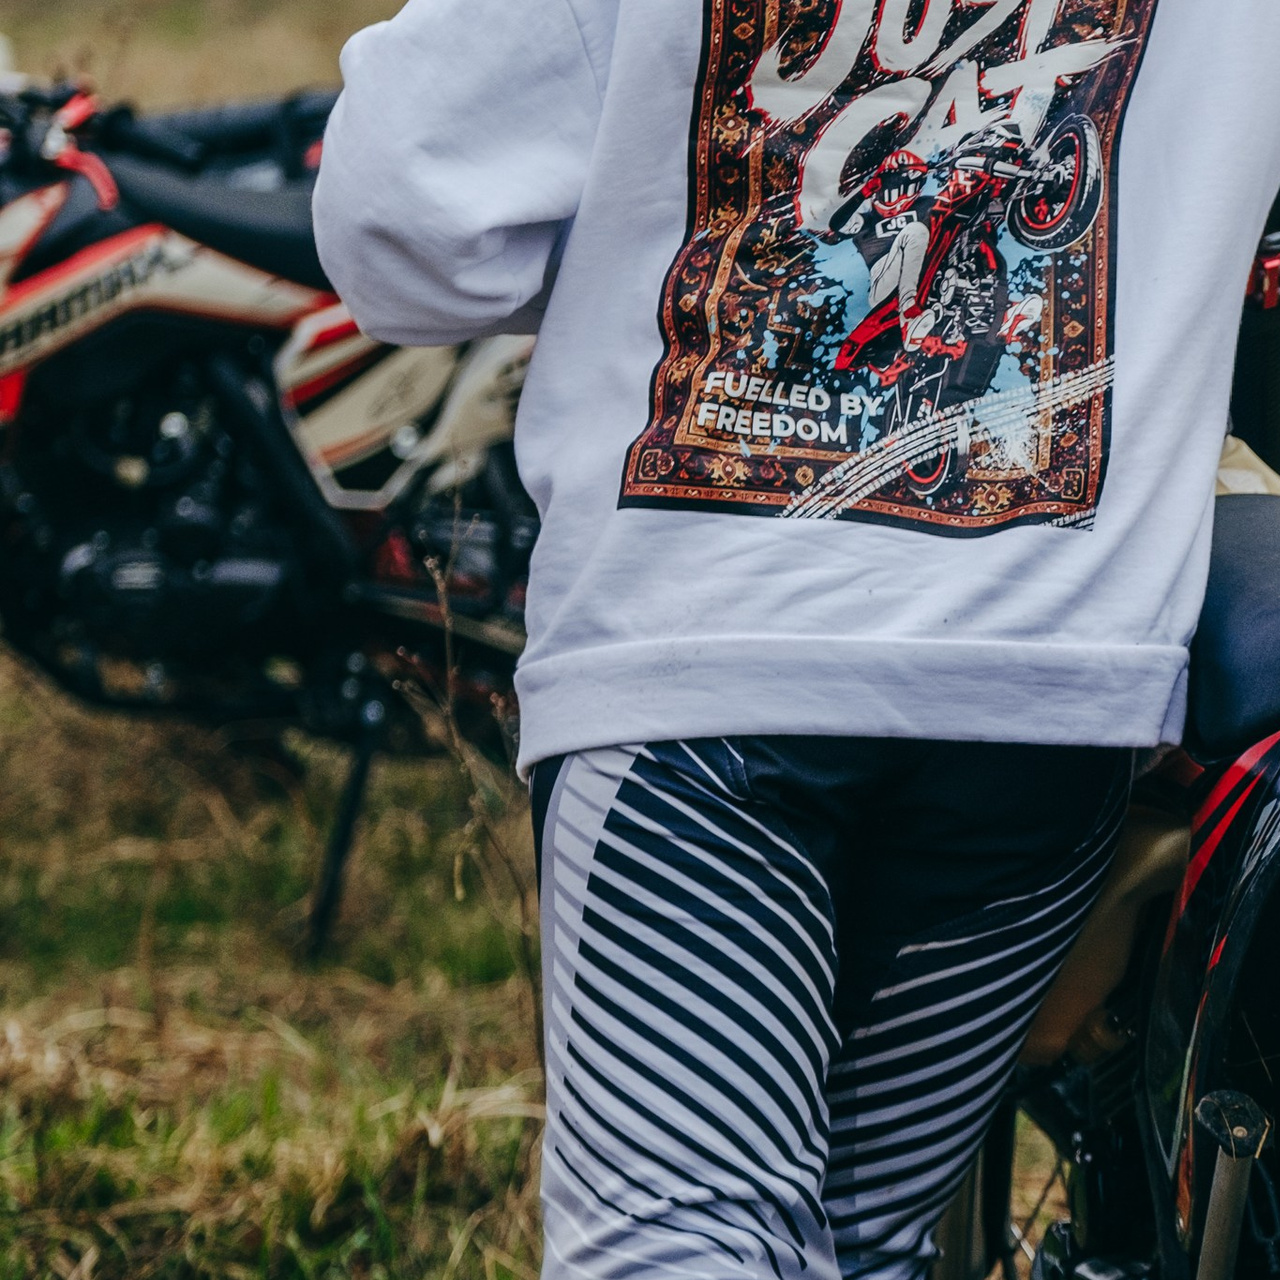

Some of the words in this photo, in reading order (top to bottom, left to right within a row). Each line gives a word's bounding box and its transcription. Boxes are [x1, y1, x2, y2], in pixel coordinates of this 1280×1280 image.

[704, 371, 831, 412] FUELLED
[840, 393, 883, 417] BY
[697, 402, 848, 444] FREEDOM
